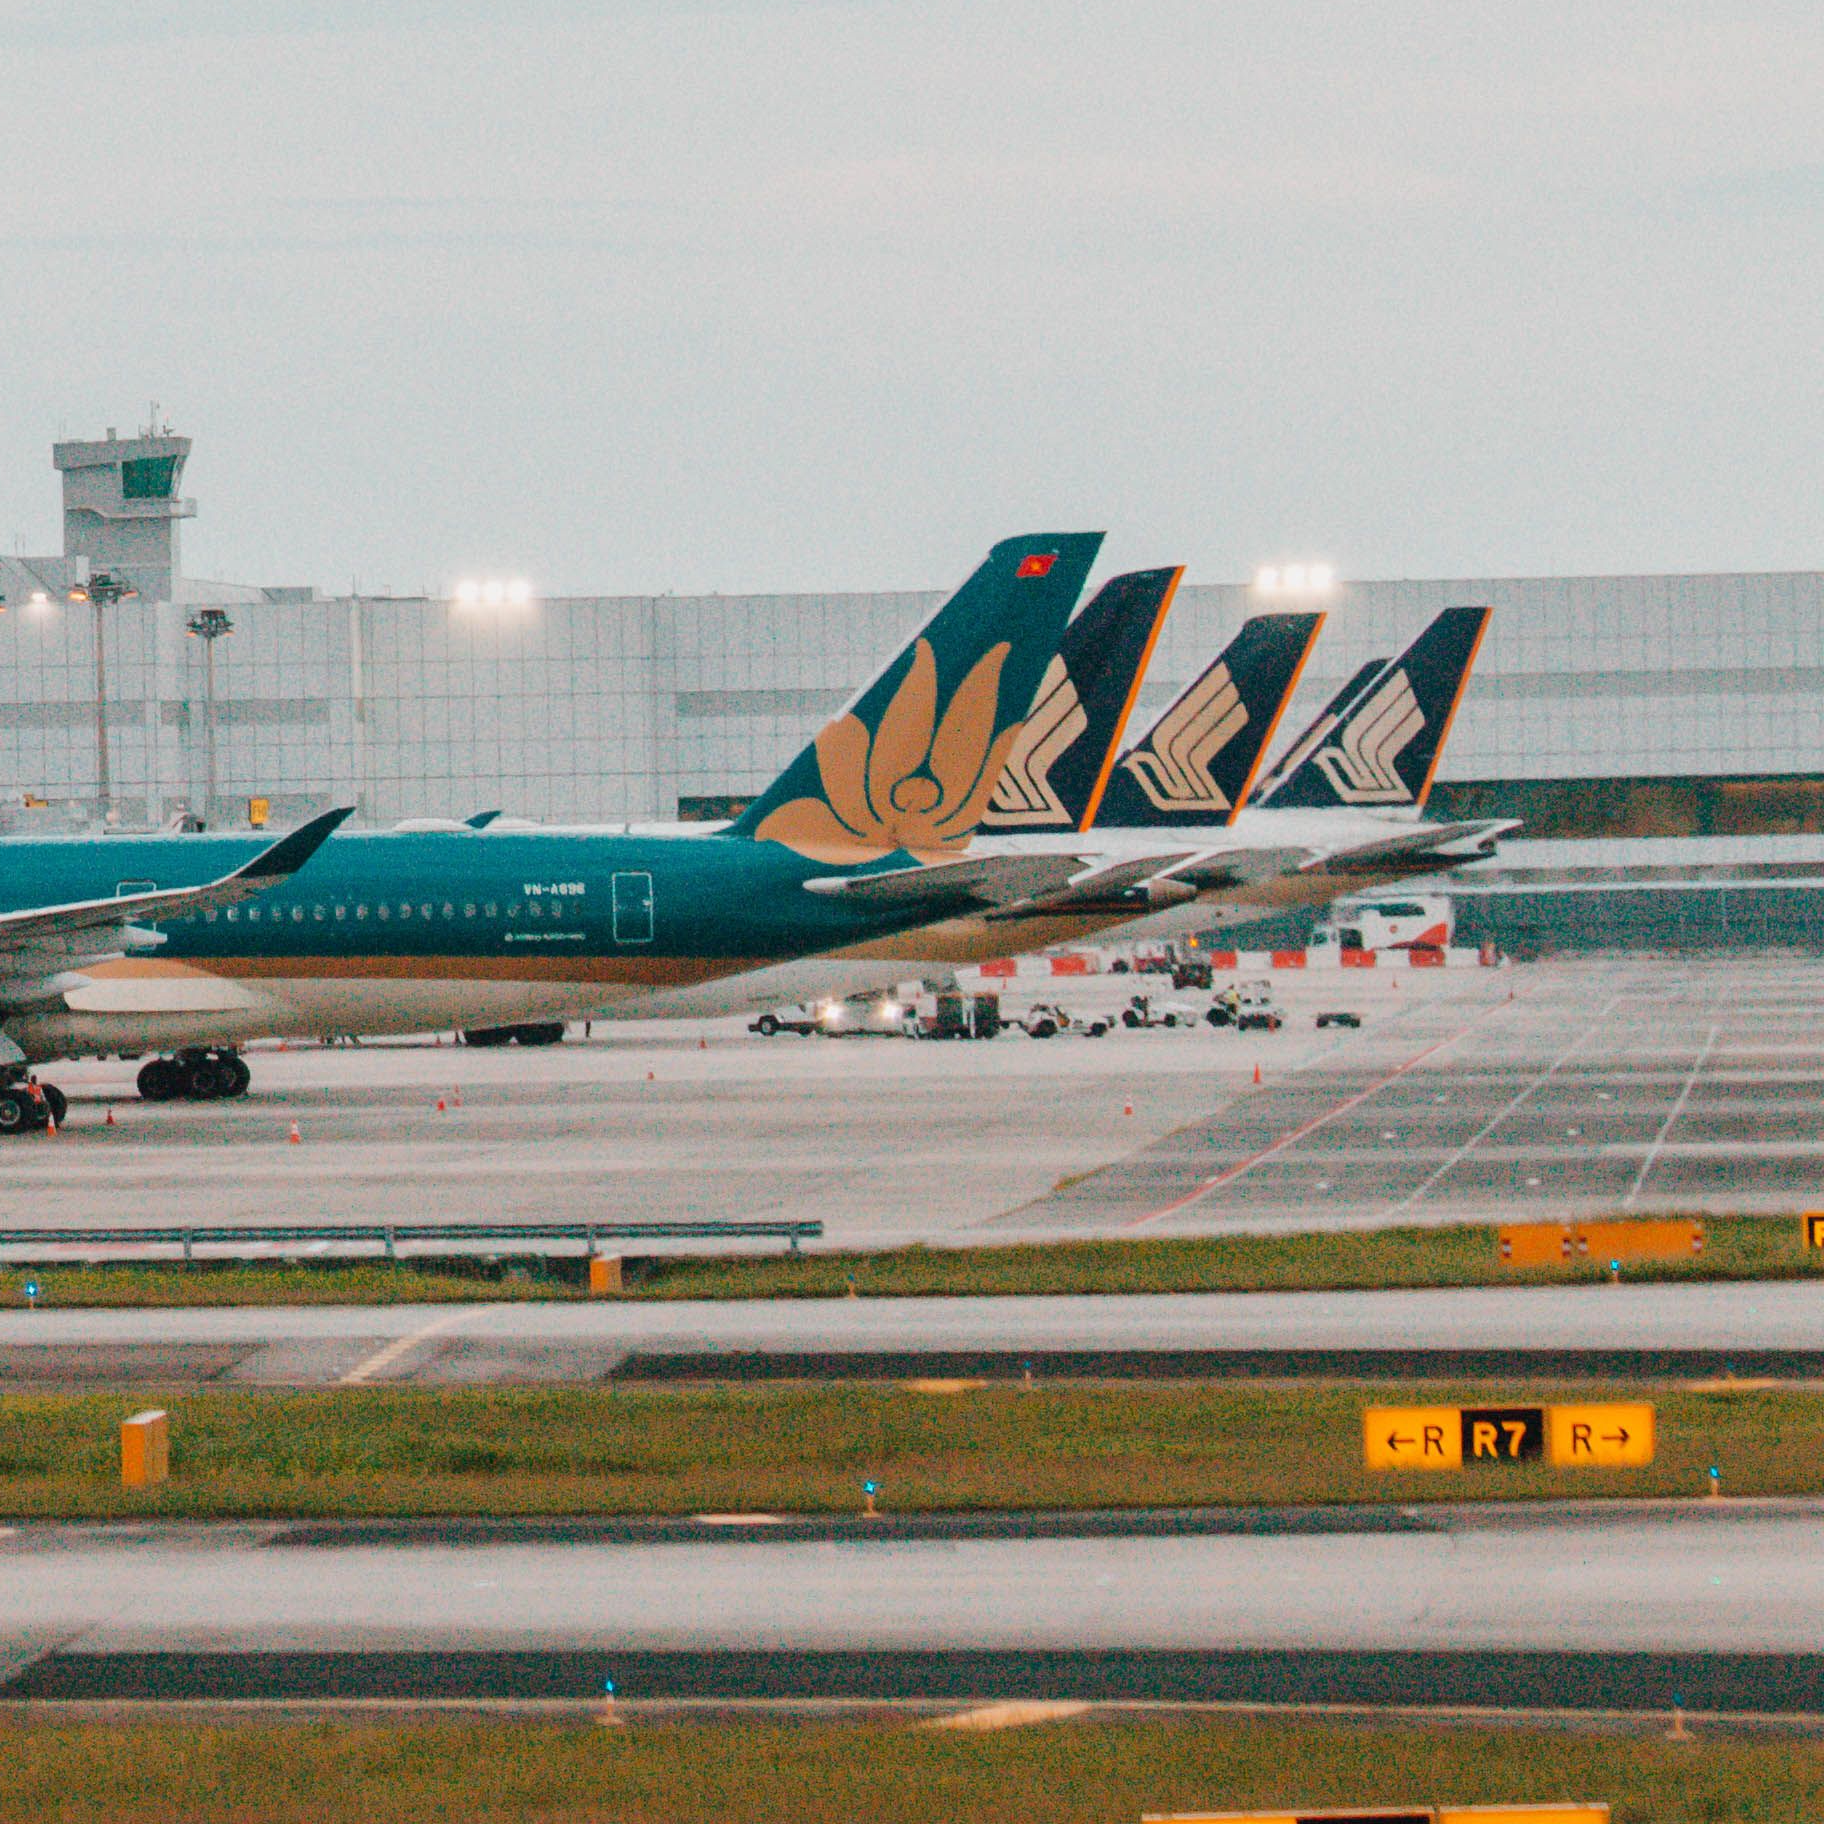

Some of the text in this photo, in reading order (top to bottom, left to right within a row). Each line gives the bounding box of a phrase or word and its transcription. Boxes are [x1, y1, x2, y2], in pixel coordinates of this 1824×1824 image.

[1423, 1421, 1593, 1459] R R7 R
